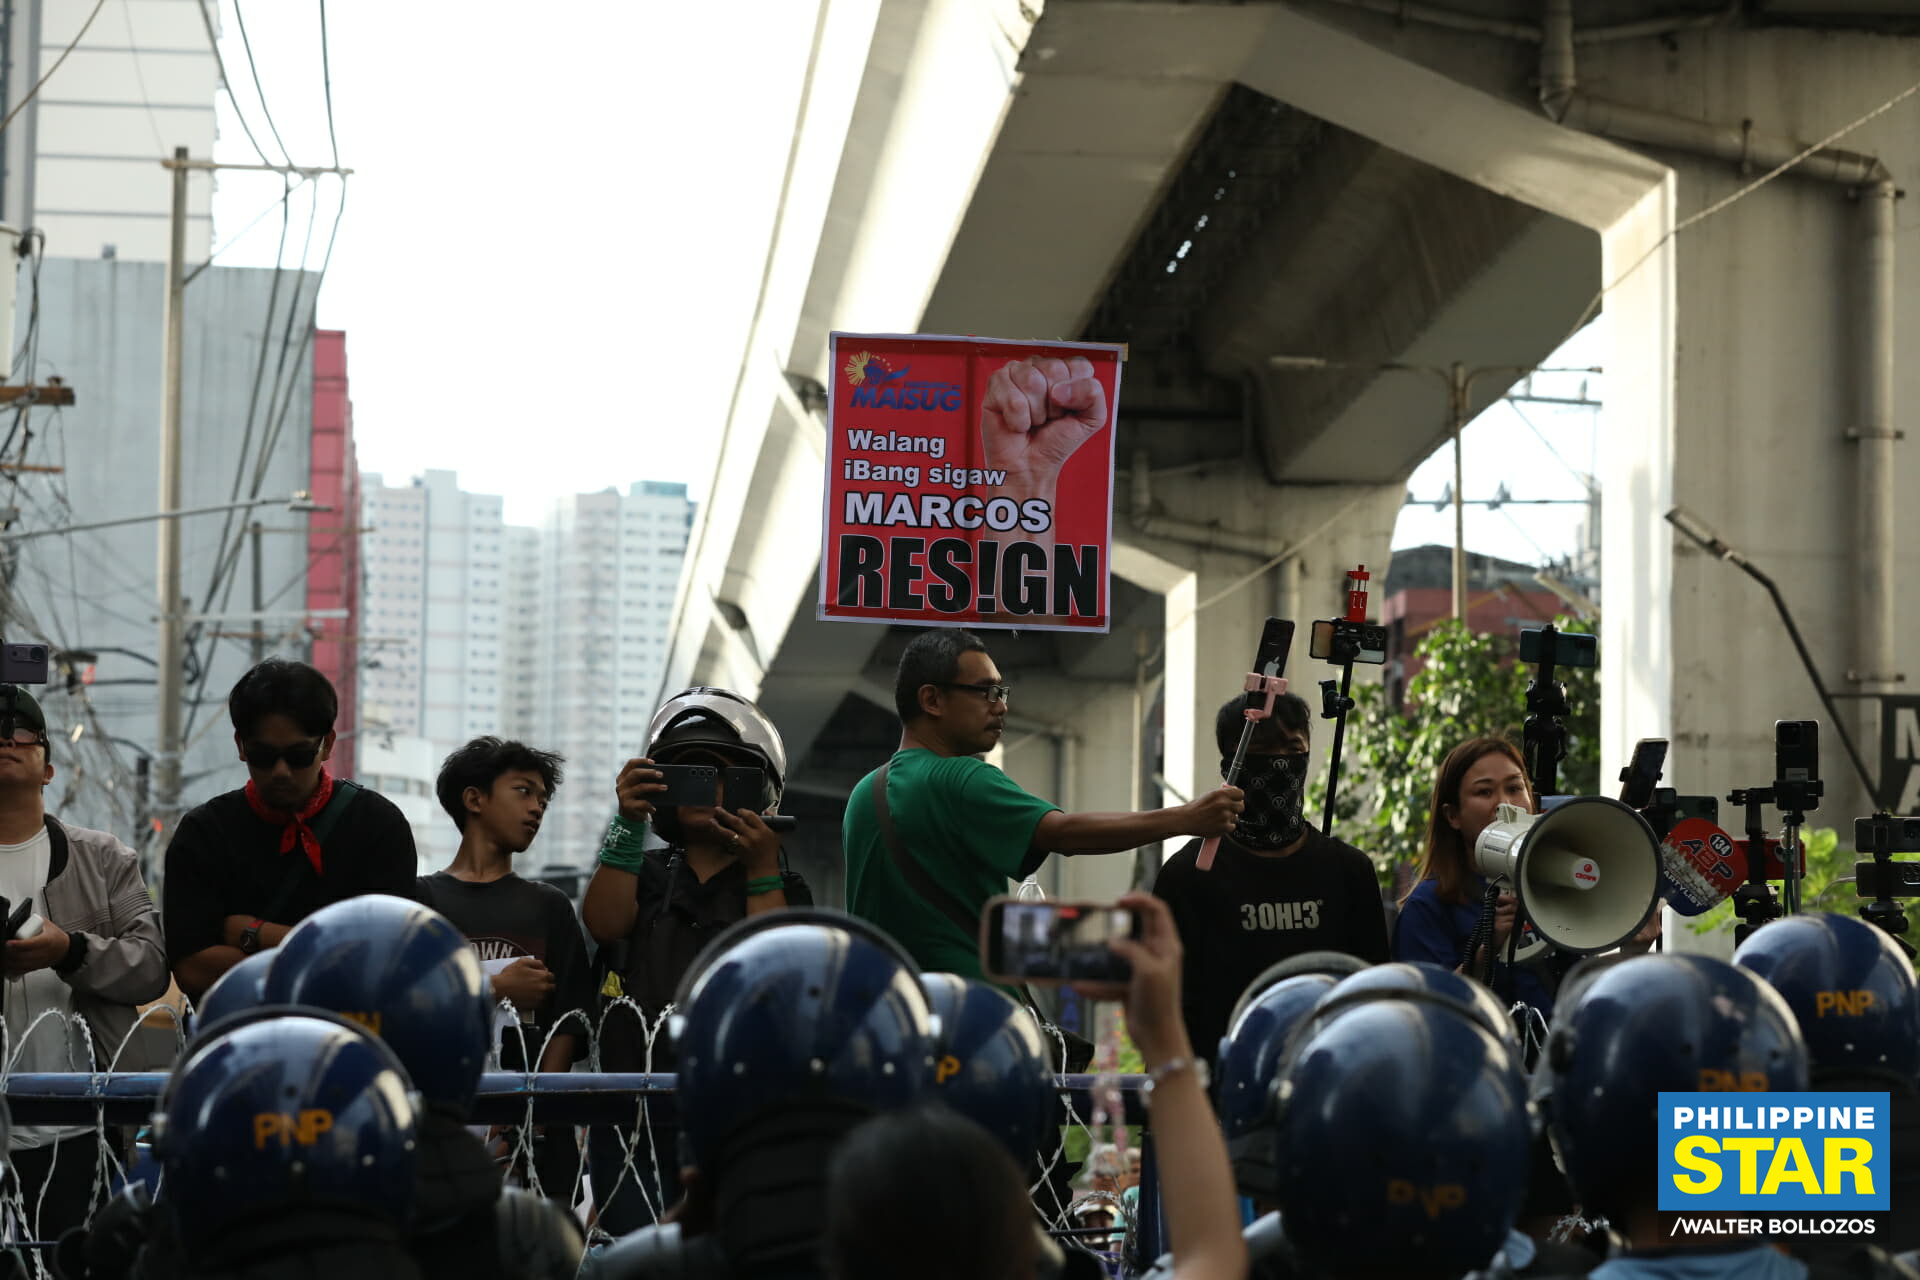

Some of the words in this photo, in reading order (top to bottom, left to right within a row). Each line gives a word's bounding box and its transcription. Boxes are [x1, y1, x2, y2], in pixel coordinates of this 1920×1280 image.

[849, 386, 962, 412] MAISUG
[847, 429, 945, 459] Walang
[844, 459, 920, 487] iBang
[928, 463, 1007, 489] sigaw
[844, 491, 1052, 534] MARCOS
[837, 533, 1100, 617] RES!GN
[1710, 835, 1731, 857] 134
[1663, 869, 1703, 908] ARTYLIST
[1815, 990, 1875, 1018] PNP
[253, 1108, 334, 1151] PNP
